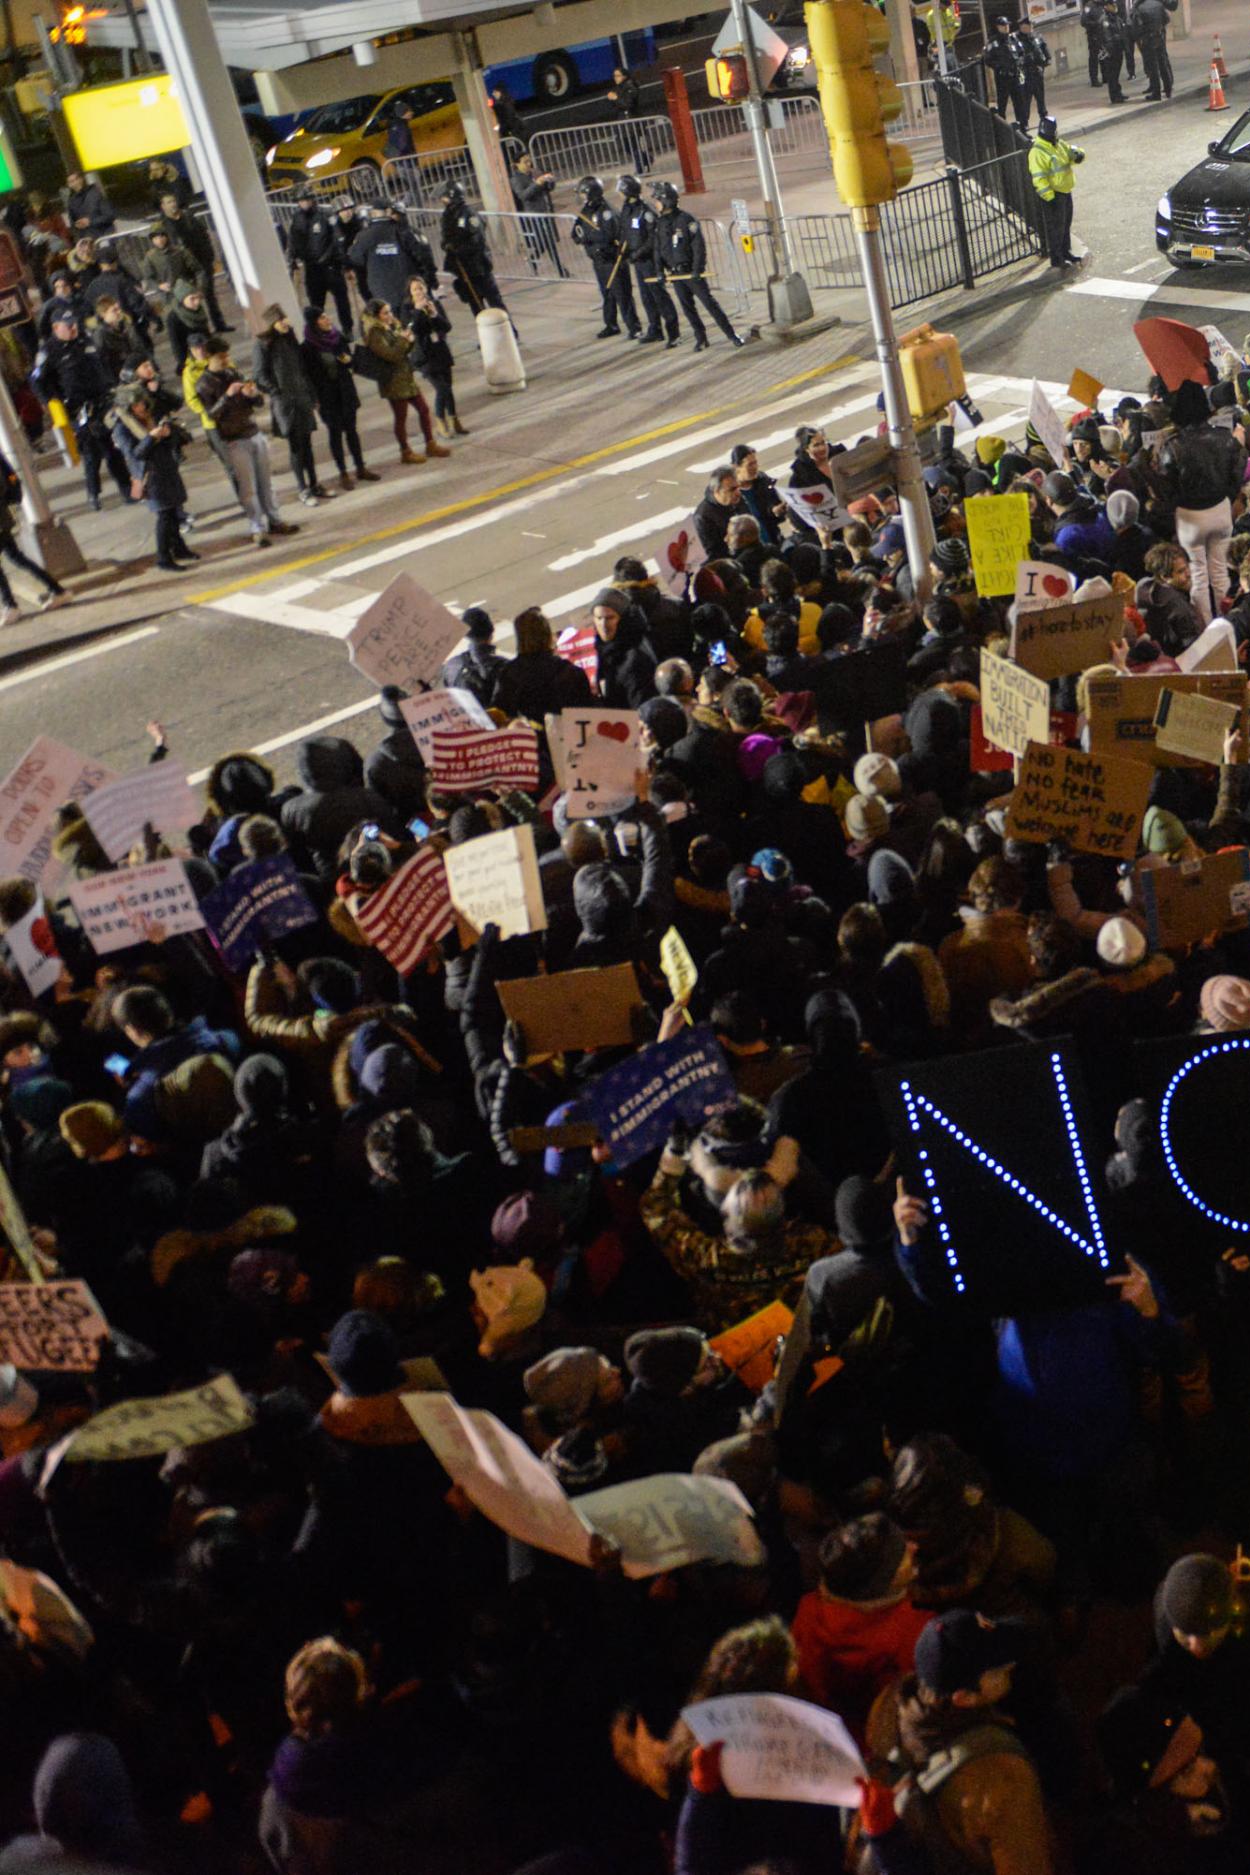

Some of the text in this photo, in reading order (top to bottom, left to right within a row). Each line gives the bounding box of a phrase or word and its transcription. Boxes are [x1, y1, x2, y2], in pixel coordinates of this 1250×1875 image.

[1024, 572, 1038, 597] I
[357, 595, 408, 655] TRUMP
[378, 612, 429, 676] PENCE
[990, 679, 1033, 721] BUILT
[449, 751, 523, 770] TO PROTECT
[465, 740, 511, 758] PLEDGE
[1028, 751, 1055, 769] NO
[1026, 771, 1054, 789] NO
[3, 775, 56, 845] OPEN TO
[89, 917, 130, 936] NEW
[618, 1077, 663, 1117] STAND
[664, 1051, 705, 1079] WITH
